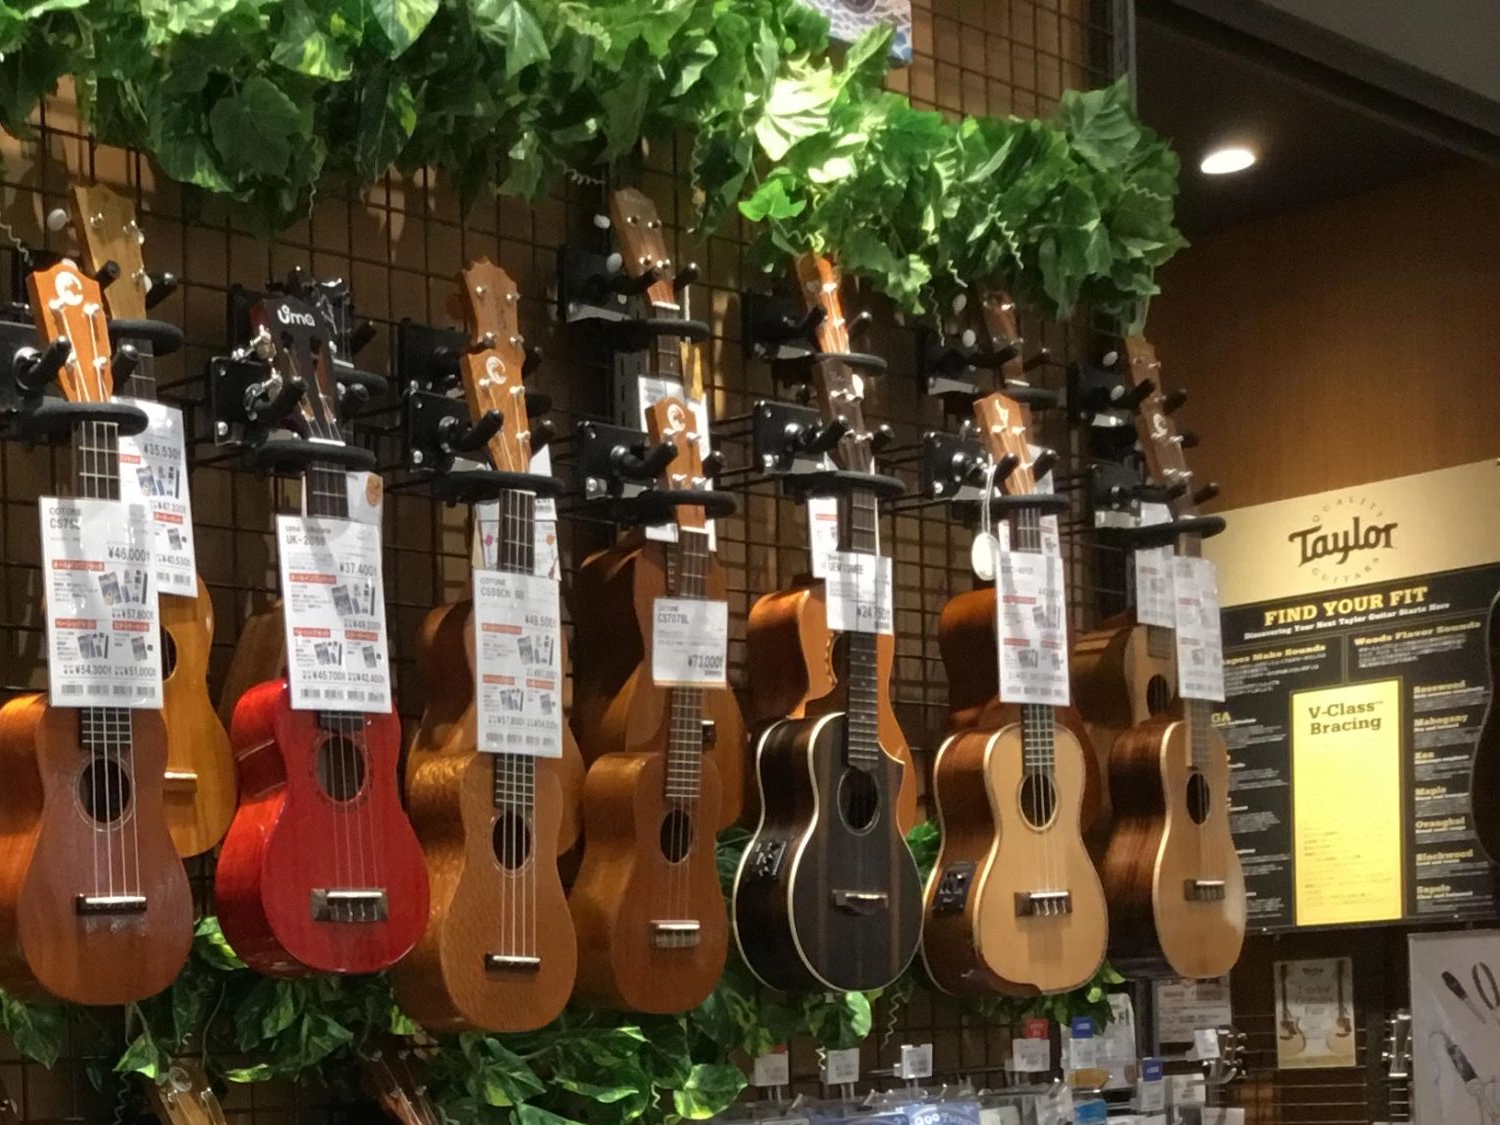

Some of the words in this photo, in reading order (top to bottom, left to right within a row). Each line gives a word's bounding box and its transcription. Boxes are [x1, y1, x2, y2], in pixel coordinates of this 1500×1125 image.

[1288, 516, 1398, 568] Taylor
[1264, 604, 1318, 627] FIND
[1322, 592, 1383, 617] YOUR
[1389, 586, 1428, 606] FIT
[1309, 716, 1382, 737] Bracing
